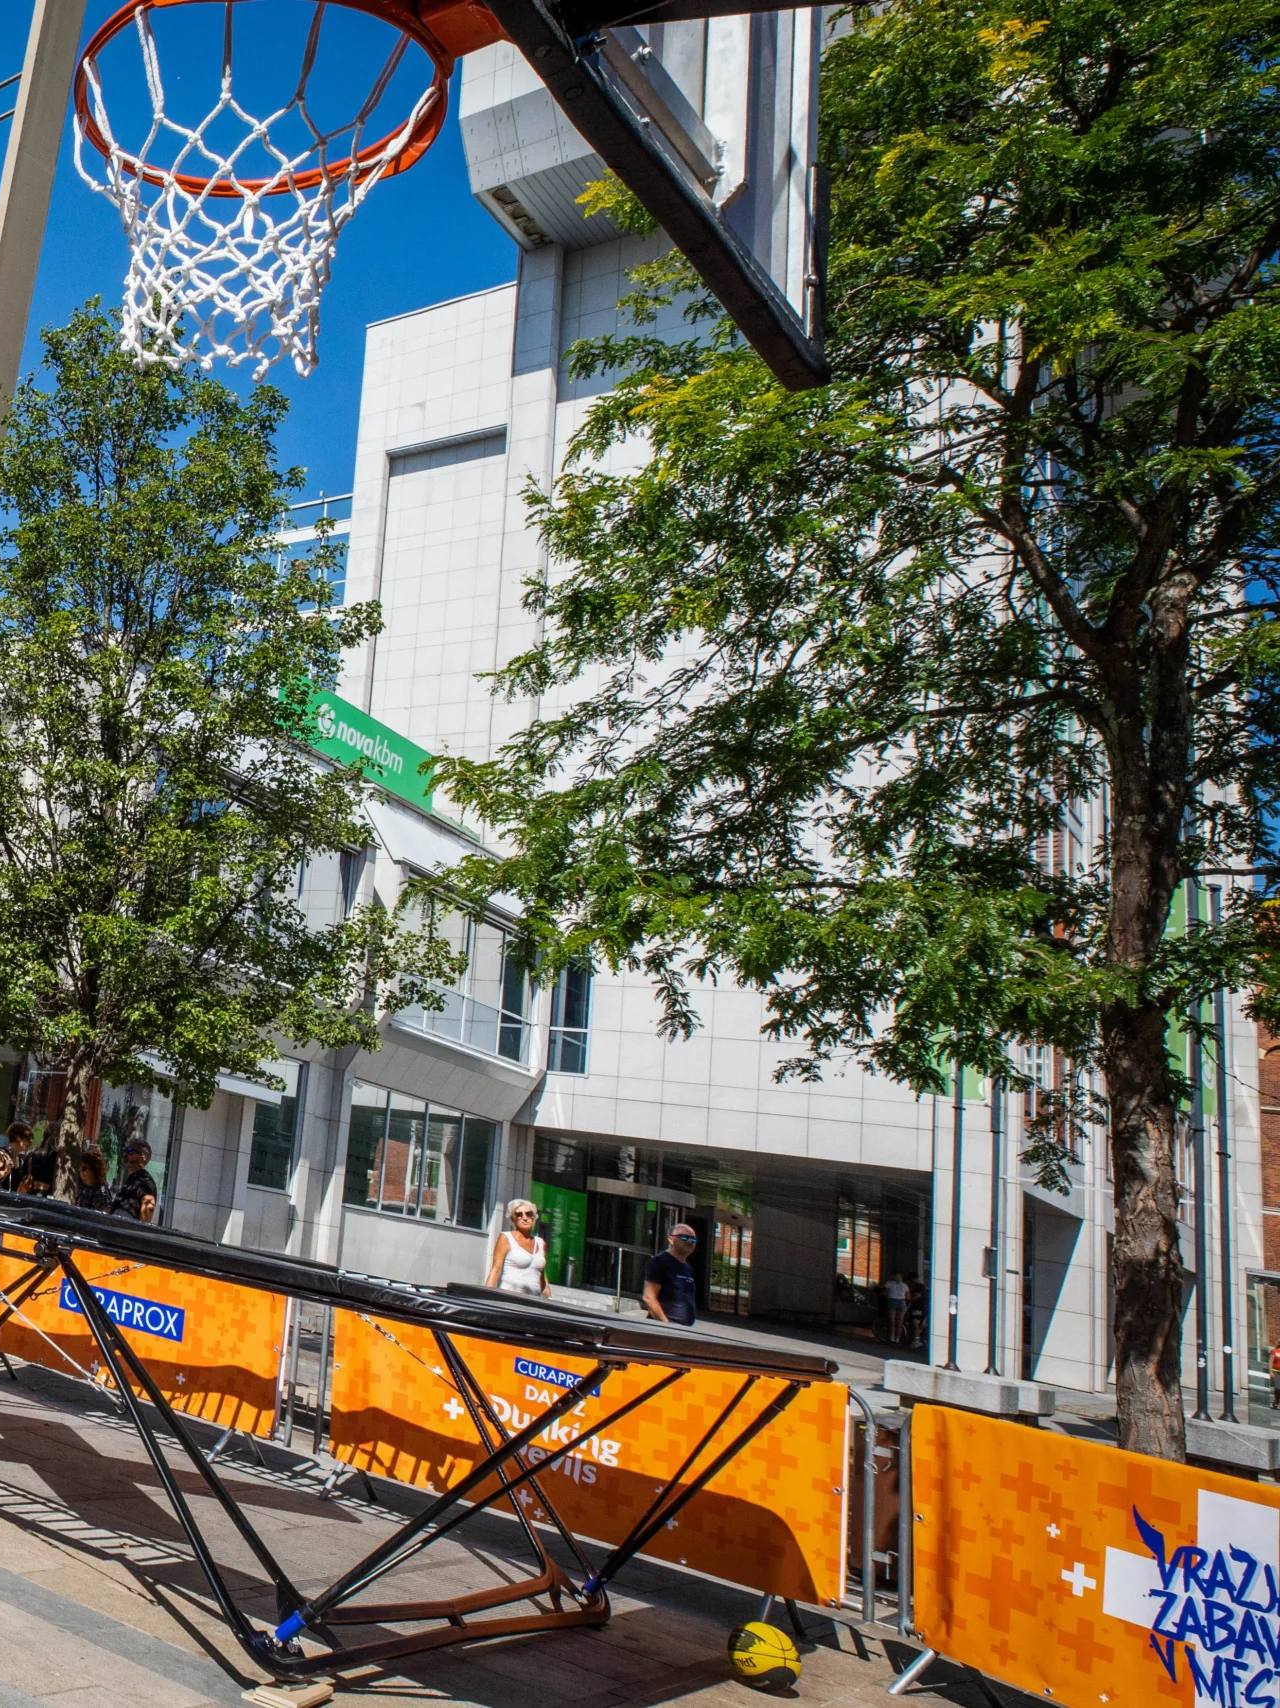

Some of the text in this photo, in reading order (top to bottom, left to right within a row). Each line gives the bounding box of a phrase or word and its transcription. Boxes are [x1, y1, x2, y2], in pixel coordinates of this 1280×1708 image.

[336, 721, 403, 775] novakbm
[64, 1285, 178, 1337] CAPROX
[517, 1361, 597, 1395] CURAPRO
[525, 1385, 559, 1407] DA
[489, 1394, 621, 1467] Duking
[508, 1430, 597, 1485] evils
[1132, 1504, 1280, 1616] VRAZJ
[1149, 1633, 1177, 1684] V
